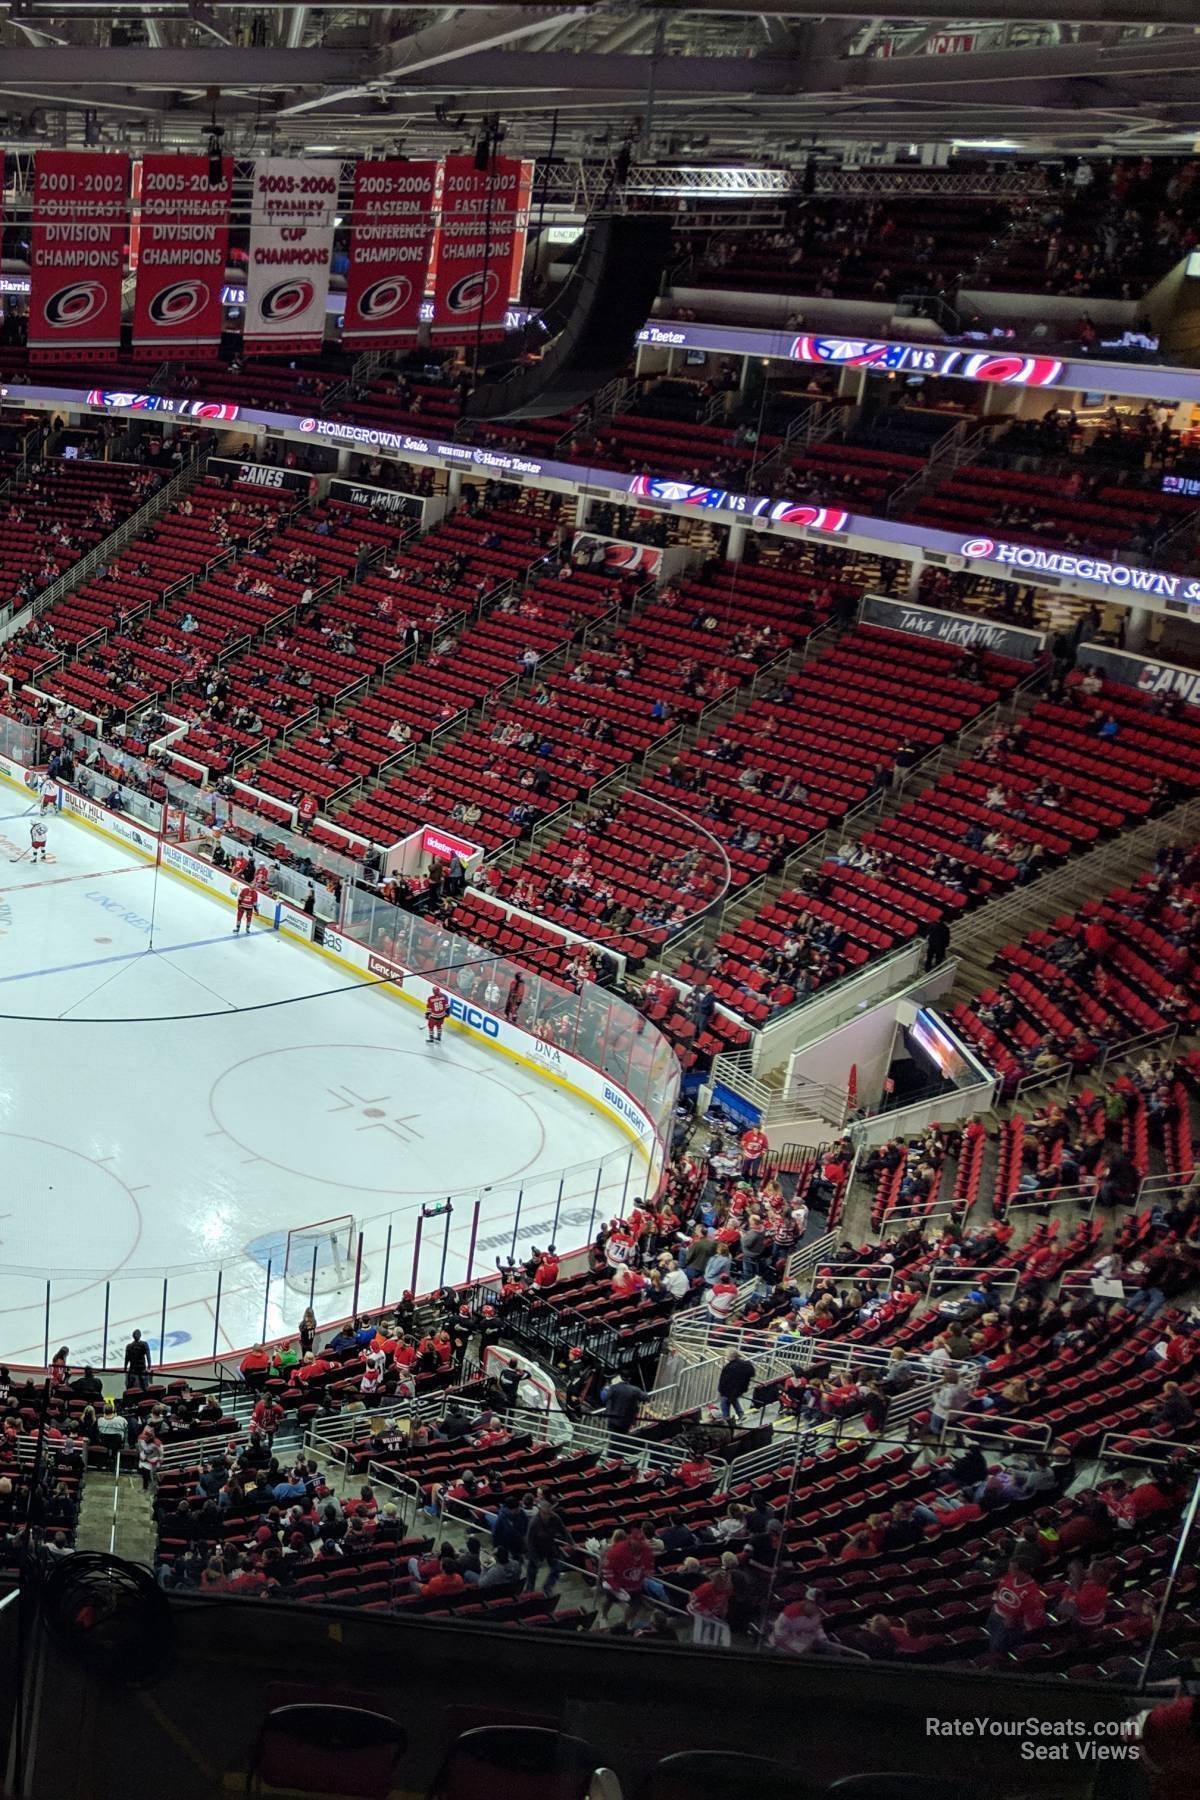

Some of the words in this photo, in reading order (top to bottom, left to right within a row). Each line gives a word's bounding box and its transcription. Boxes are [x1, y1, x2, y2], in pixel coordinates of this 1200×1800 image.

[39, 173, 123, 192] 2001-2002
[258, 175, 336, 194] 2005-2006
[359, 176, 432, 193] 2005-2006
[448, 175, 517, 192] 2001-2002
[38, 199, 122, 217] SOUTHEAST
[145, 199, 228, 217] SOUTHEAST
[266, 200, 325, 217] STANLEY
[366, 200, 421, 216] EASTERN
[455, 198, 506, 213] EASTERN
[46, 225, 112, 242] DIVISION
[153, 224, 215, 241] DIVISION
[280, 227, 307, 242] CUP
[355, 226, 427, 241] CONFERENCE
[443, 220, 513, 236] CONFERENCE
[35, 250, 119, 268] CHAMPIONS
[143, 249, 222, 266] CHAMPIONS
[254, 247, 329, 265] CHAMPIONS
[354, 246, 424, 263] CHAMPIONS
[442, 242, 511, 259] CHAMPIONS
[0, 280, 31, 292] Harris
[230, 290, 245, 302] VS
[650, 328, 685, 344] Teeter
[911, 351, 935, 369] VS
[162, 399, 174, 411] VS
[317, 420, 402, 449] HOMEGROWN
[403, 437, 429, 452] Series
[483, 453, 511, 469] Harris
[512, 459, 541, 475] Teeter
[237, 464, 285, 489] CANES
[349, 487, 370, 505] TAKE
[370, 490, 406, 513] WARNING
[729, 495, 747, 511] VS
[995, 543, 1181, 597] HOMEGROWN
[898, 609, 935, 633] TAKE
[937, 620, 1009, 650] WARNING
[1136, 665, 1200, 705] CANE
[64, 792, 88, 810] BULLY
[88, 803, 105, 822] HILL
[322, 930, 343, 953] sas
[450, 997, 500, 1038] EICO
[534, 1039, 562, 1063] DNA
[604, 1087, 624, 1110] BUD
[623, 1105, 646, 1133] LIGHT
[613, 1244, 626, 1257] 74
